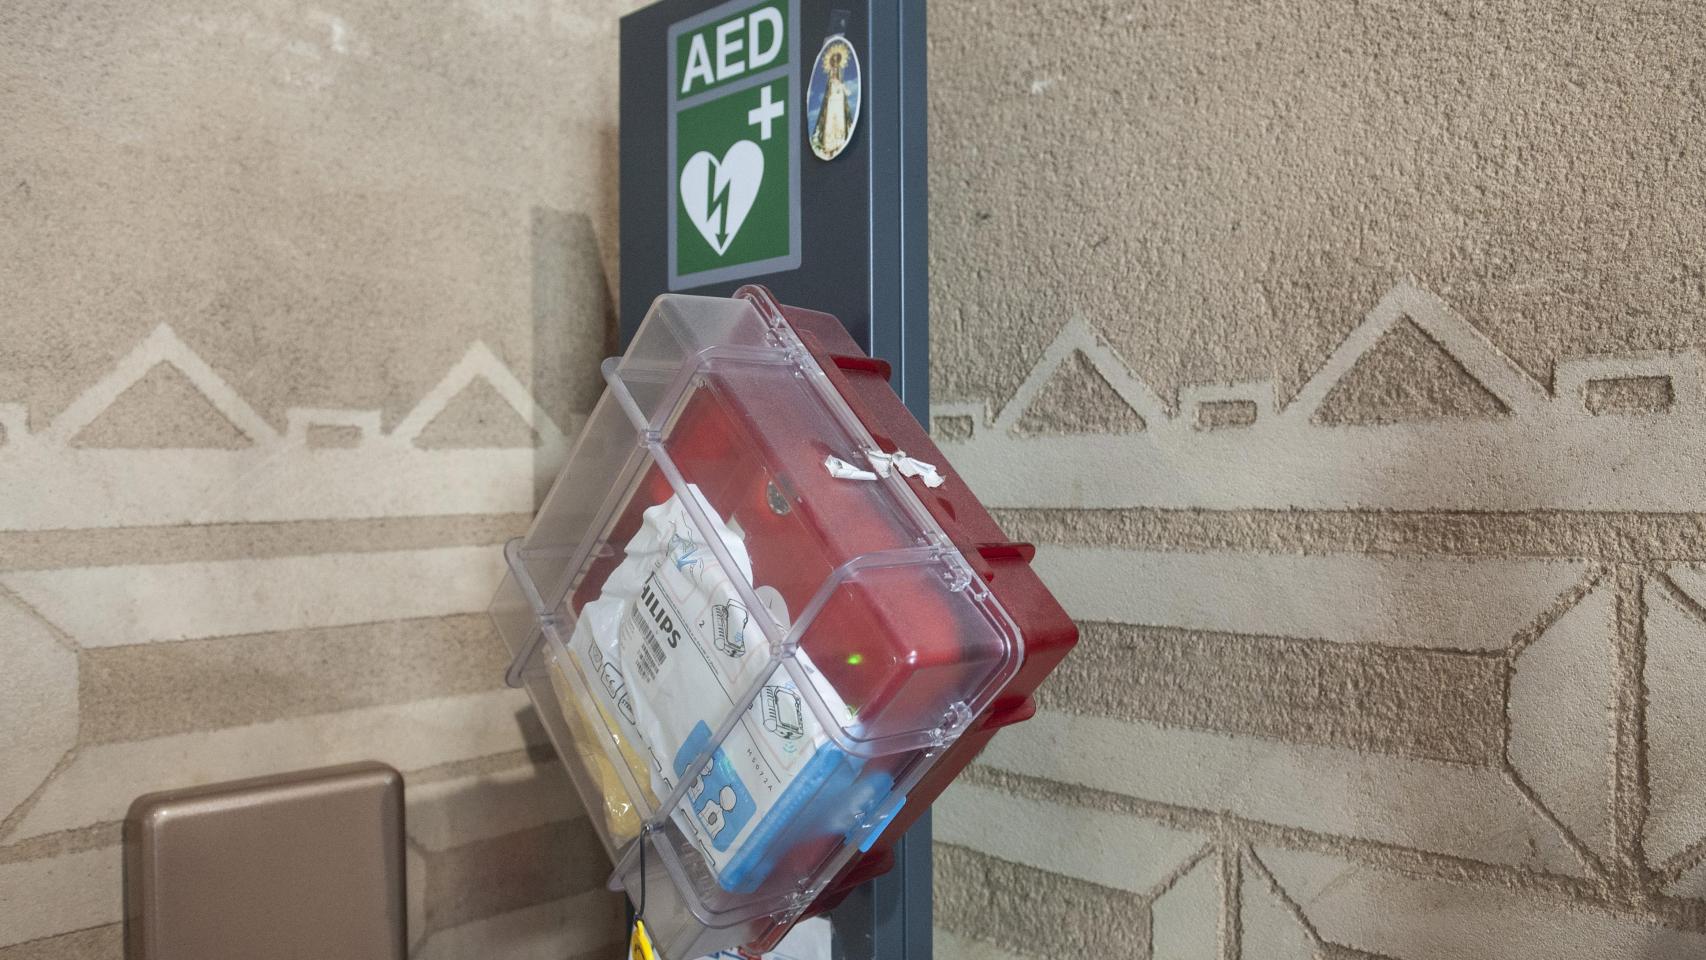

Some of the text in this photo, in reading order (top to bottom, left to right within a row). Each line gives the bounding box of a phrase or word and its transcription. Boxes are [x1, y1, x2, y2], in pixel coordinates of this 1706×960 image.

[681, 6, 784, 93] AED
[641, 584, 681, 649] HILIPS
[698, 619, 705, 629] 2
